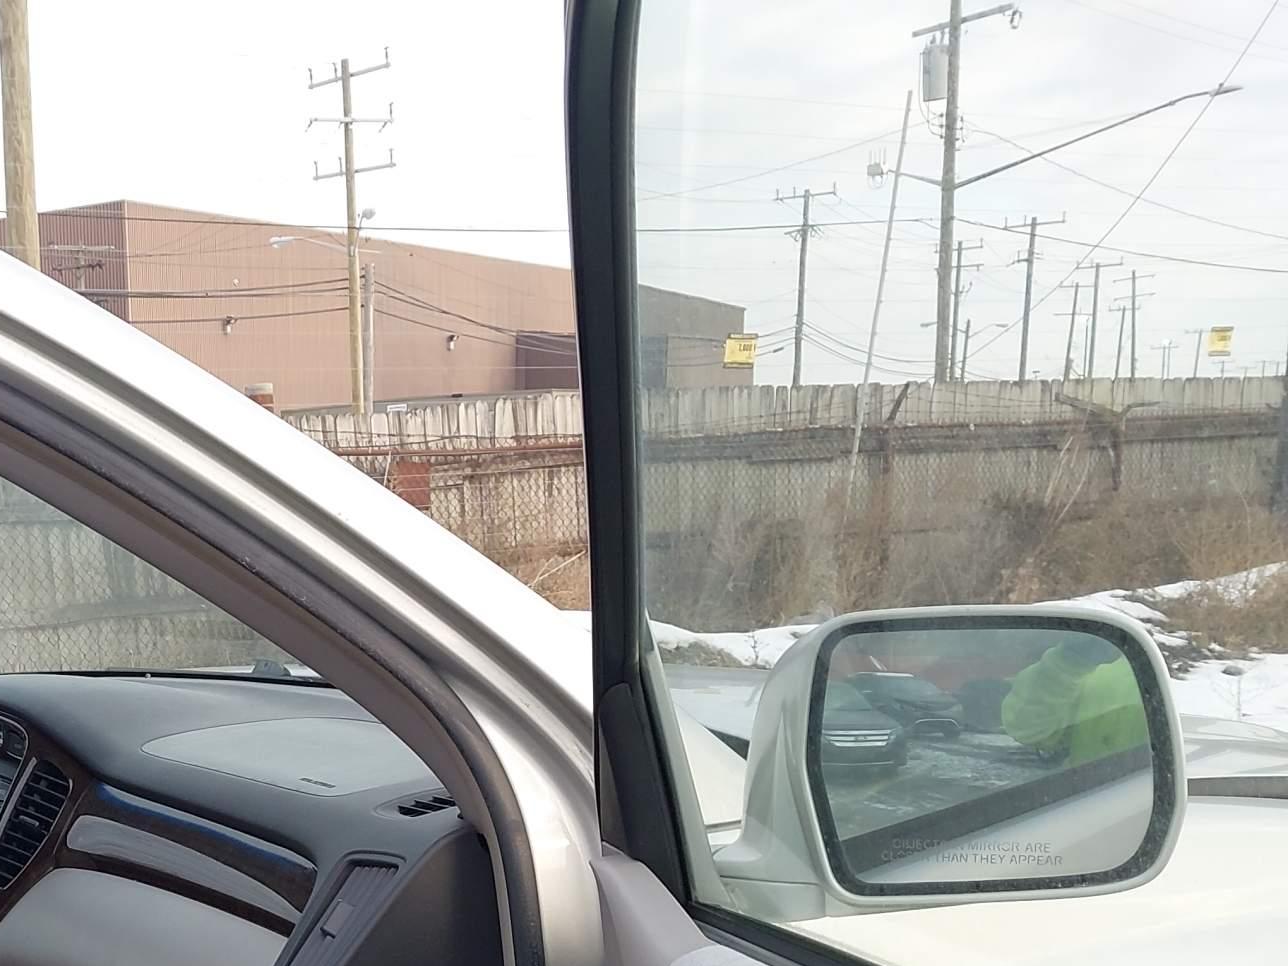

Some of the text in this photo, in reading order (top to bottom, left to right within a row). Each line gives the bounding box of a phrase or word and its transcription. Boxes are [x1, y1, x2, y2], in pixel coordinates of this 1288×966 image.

[892, 839, 948, 850] OBJECT
[1025, 842, 1052, 853] ARE
[935, 852, 969, 864] THAN
[973, 853, 1005, 865] THEY
[1010, 854, 1063, 866] APPEAR
